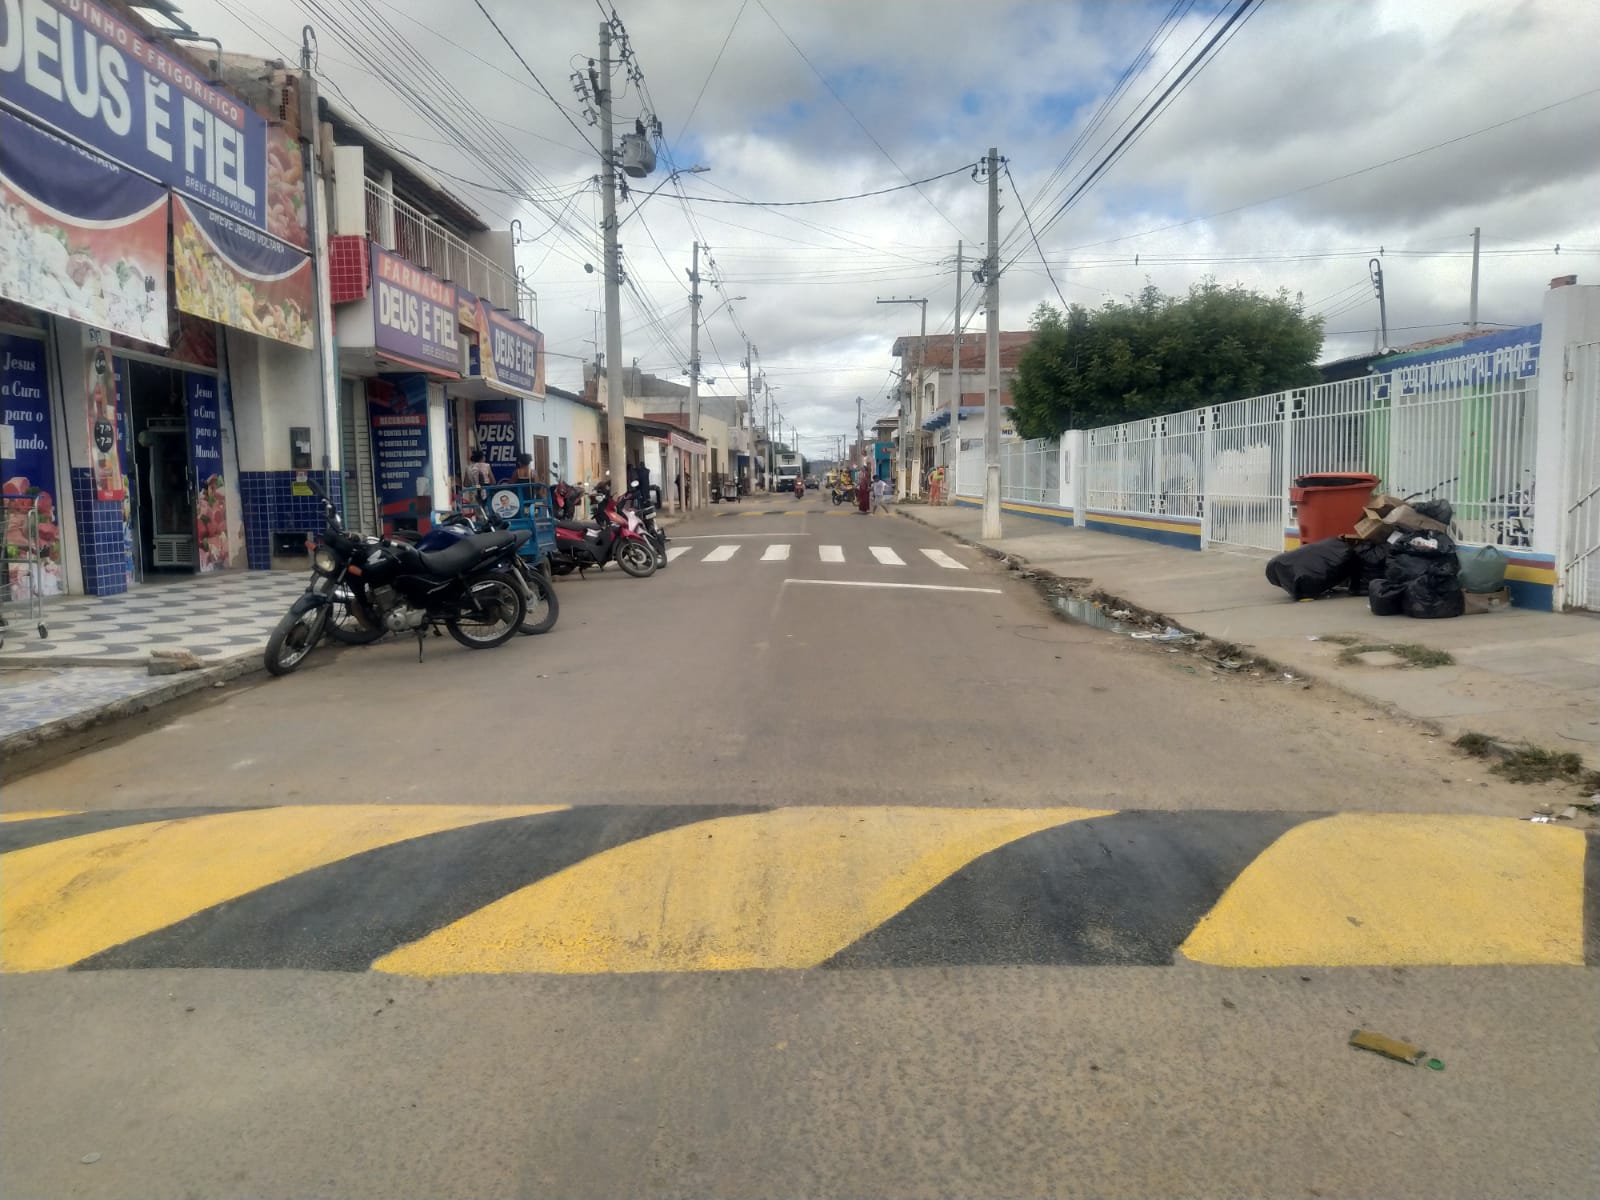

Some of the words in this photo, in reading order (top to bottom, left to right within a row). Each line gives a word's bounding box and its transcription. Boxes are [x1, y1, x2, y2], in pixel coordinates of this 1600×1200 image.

[60, 0, 127, 45] DINHO
[132, 41, 142, 56] E
[143, 69, 173, 162] É
[183, 96, 256, 207] FIEL
[379, 282, 418, 336] DEUS
[433, 306, 459, 350] FIEL
[495, 328, 515, 369] DEUS
[3, 352, 36, 371] Jesus
[1, 385, 10, 396] a
[12, 380, 41, 399] Cura
[194, 383, 213, 399] Jesus
[4, 409, 33, 425] para
[36, 412, 44, 422] o
[194, 408, 200, 417] a
[199, 405, 216, 420] Cura
[14, 433, 48, 450] undo.
[195, 427, 212, 440] para
[477, 424, 515, 442] DEUS
[195, 444, 220, 459] Mundo.
[489, 445, 518, 462] FIEL
